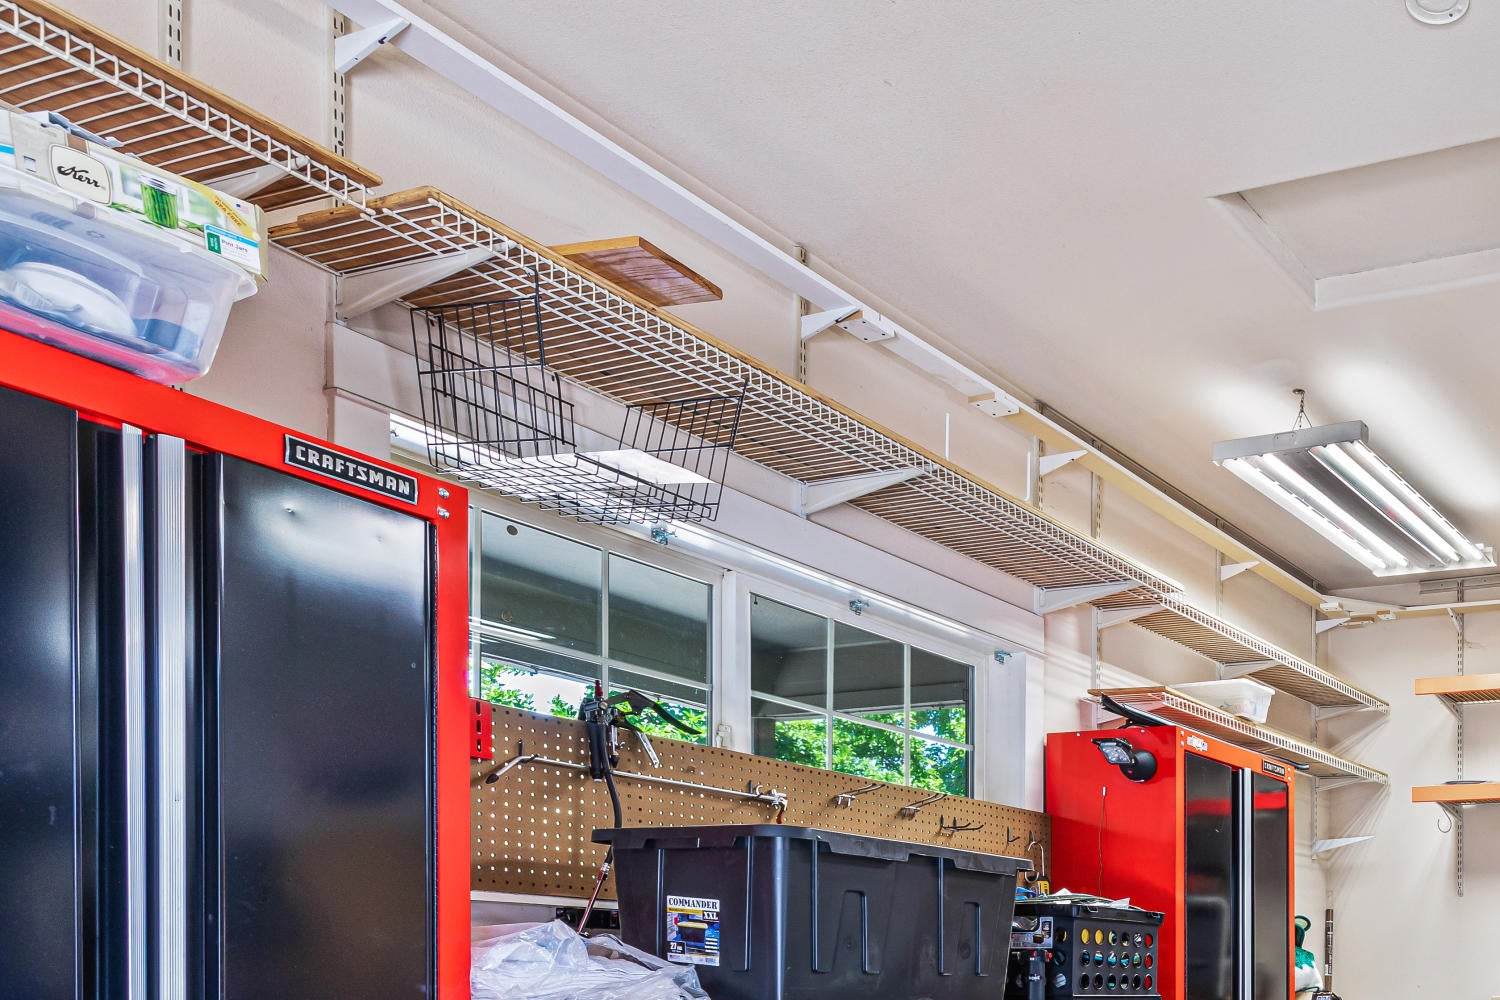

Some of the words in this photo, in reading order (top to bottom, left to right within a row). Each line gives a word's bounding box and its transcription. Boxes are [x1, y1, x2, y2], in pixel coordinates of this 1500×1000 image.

[57, 166, 101, 188] Kerr
[295, 445, 410, 495] CRAFTSMAN
[668, 897, 718, 910] COMMANDER
[703, 911, 719, 920] XXL
[670, 942, 677, 950] 27
